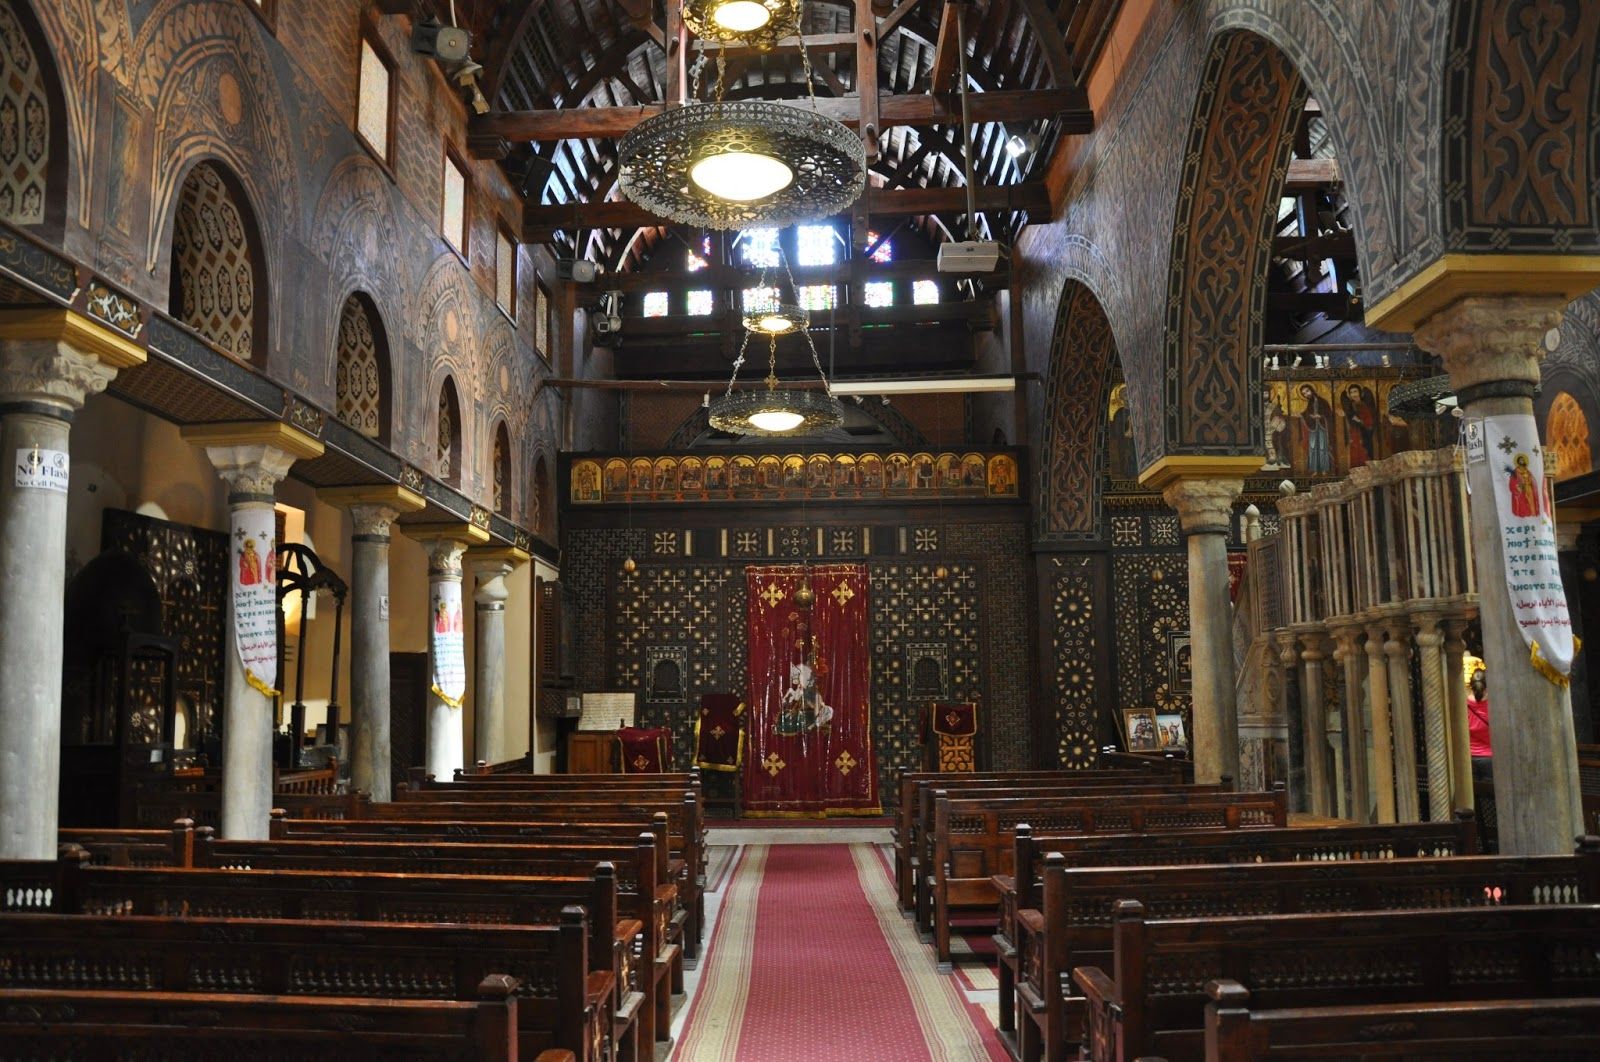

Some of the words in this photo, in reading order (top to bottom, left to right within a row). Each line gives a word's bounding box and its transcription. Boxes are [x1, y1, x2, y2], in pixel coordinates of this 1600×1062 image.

[17, 464, 36, 476] No
[42, 465, 68, 480] Flash
[17, 479, 29, 487] No
